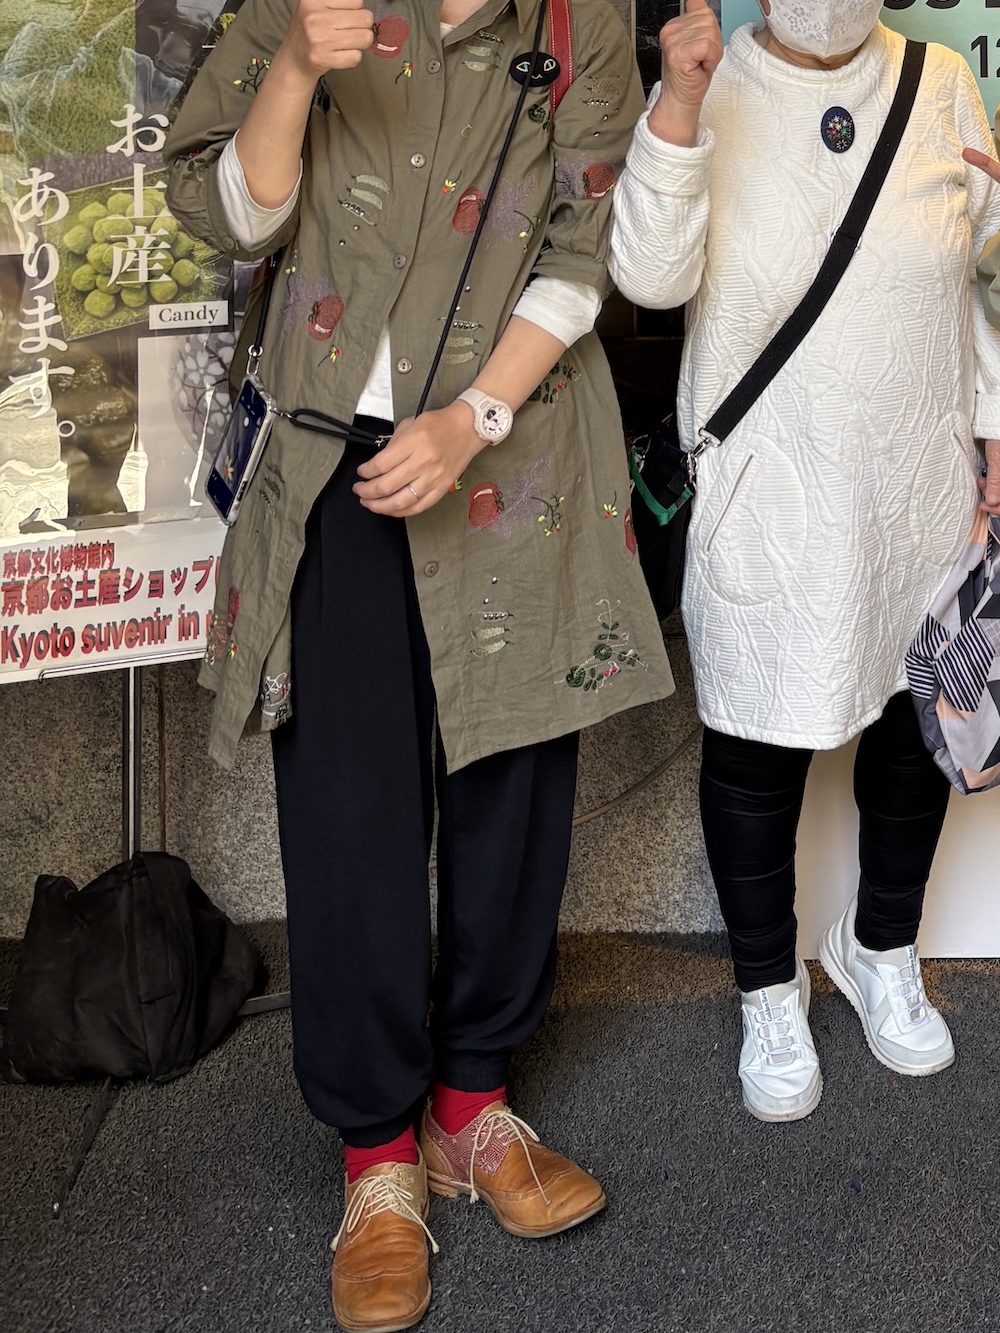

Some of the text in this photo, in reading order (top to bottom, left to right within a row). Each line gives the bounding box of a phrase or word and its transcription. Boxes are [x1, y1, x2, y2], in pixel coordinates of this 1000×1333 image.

[106, 103, 172, 287] お土産
[8, 167, 76, 438] あります。
[159, 305, 219, 324] Candy
[1, 555, 221, 617] 京都お土産ショップ
[3, 539, 115, 579] 京都文化博物館内
[1, 622, 75, 670] Kyoto
[81, 606, 172, 655] suvenir
[177, 603, 200, 642] in
